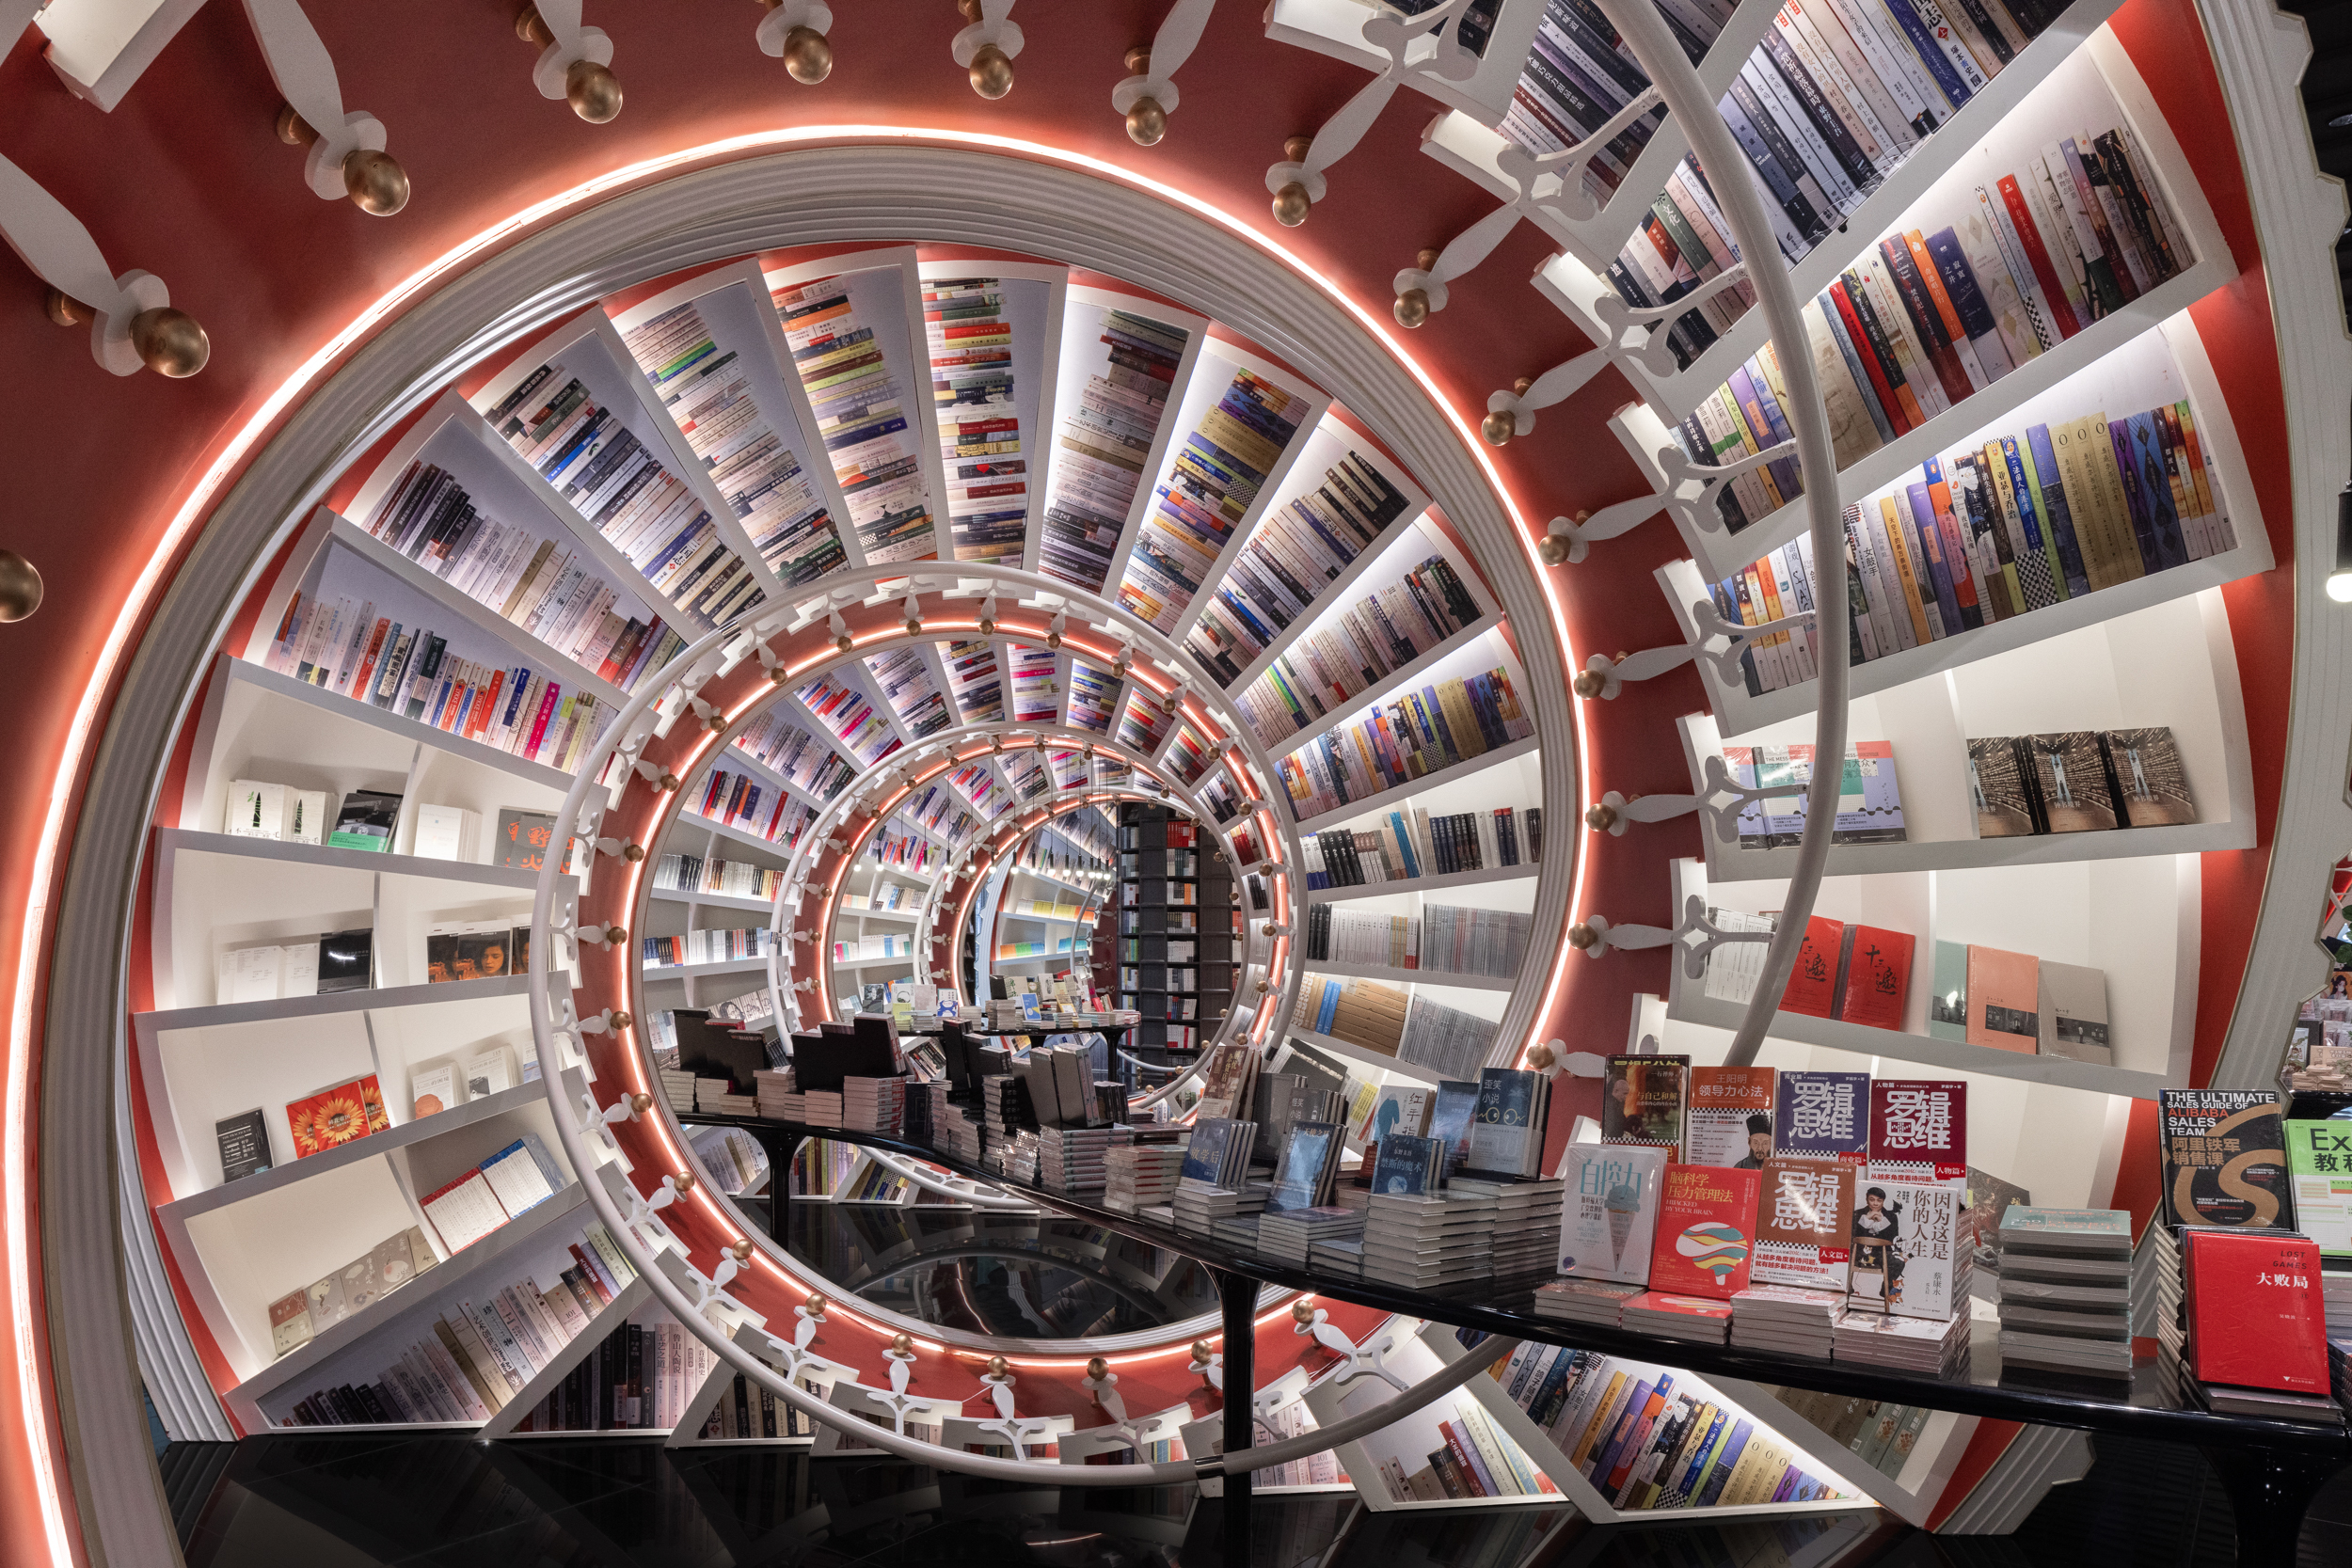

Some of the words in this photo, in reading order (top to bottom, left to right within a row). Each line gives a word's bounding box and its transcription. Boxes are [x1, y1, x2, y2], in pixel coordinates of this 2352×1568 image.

[1829, 89, 1853, 121] 村上春樹
[1857, 102, 1880, 133] 村上春樹
[1997, 471, 2016, 520] 亚瑟与乔治
[1889, 517, 1910, 577] 天空下的两万条街道
[1864, 547, 1878, 577] 女鼓手
[1866, 944, 1898, 995] 十三邀
[1484, 1079, 1502, 1091] 歪笑
[1716, 1074, 1747, 1084] 王阳明
[1482, 1093, 1500, 1104] 小说
[1637, 1092, 1677, 1101] 与自己和解
[1699, 1085, 1763, 1097] 领导力心法
[1792, 1082, 1855, 1117] 罗辑
[2166, 1092, 2196, 1102] THE
[2201, 1093, 2276, 1103] ULTIMATE
[1884, 1090, 1952, 1126] 罗辑
[2168, 1108, 2229, 1117] ALIBABA
[1791, 1109, 1853, 1139] 思维
[2169, 1117, 2217, 1128] SALES
[2169, 1128, 2205, 1136] TEAM
[1883, 1118, 1951, 1149] 思维
[2310, 1128, 2352, 1151] Ex
[2171, 1137, 2241, 1153] 阿里铁军
[1190, 1148, 1220, 1164] 放学后
[1380, 1158, 1422, 1173] 禁断的魔术
[2172, 1151, 2224, 1166] 销售课
[1581, 1159, 1642, 1199] 自控力
[1670, 1172, 1709, 1186] 脑科学
[1668, 1186, 1733, 1203] 压力管理法
[1774, 1171, 1840, 1210] 罗辑
[1771, 1202, 1837, 1233] 思维
[1912, 1190, 1931, 1258] 你的人生
[1931, 1192, 1950, 1260] 因为这是
[2273, 1261, 2308, 1270] GAMES
[1932, 1272, 1942, 1295] 蔡康永
[2256, 1272, 2309, 1289] 大败局
